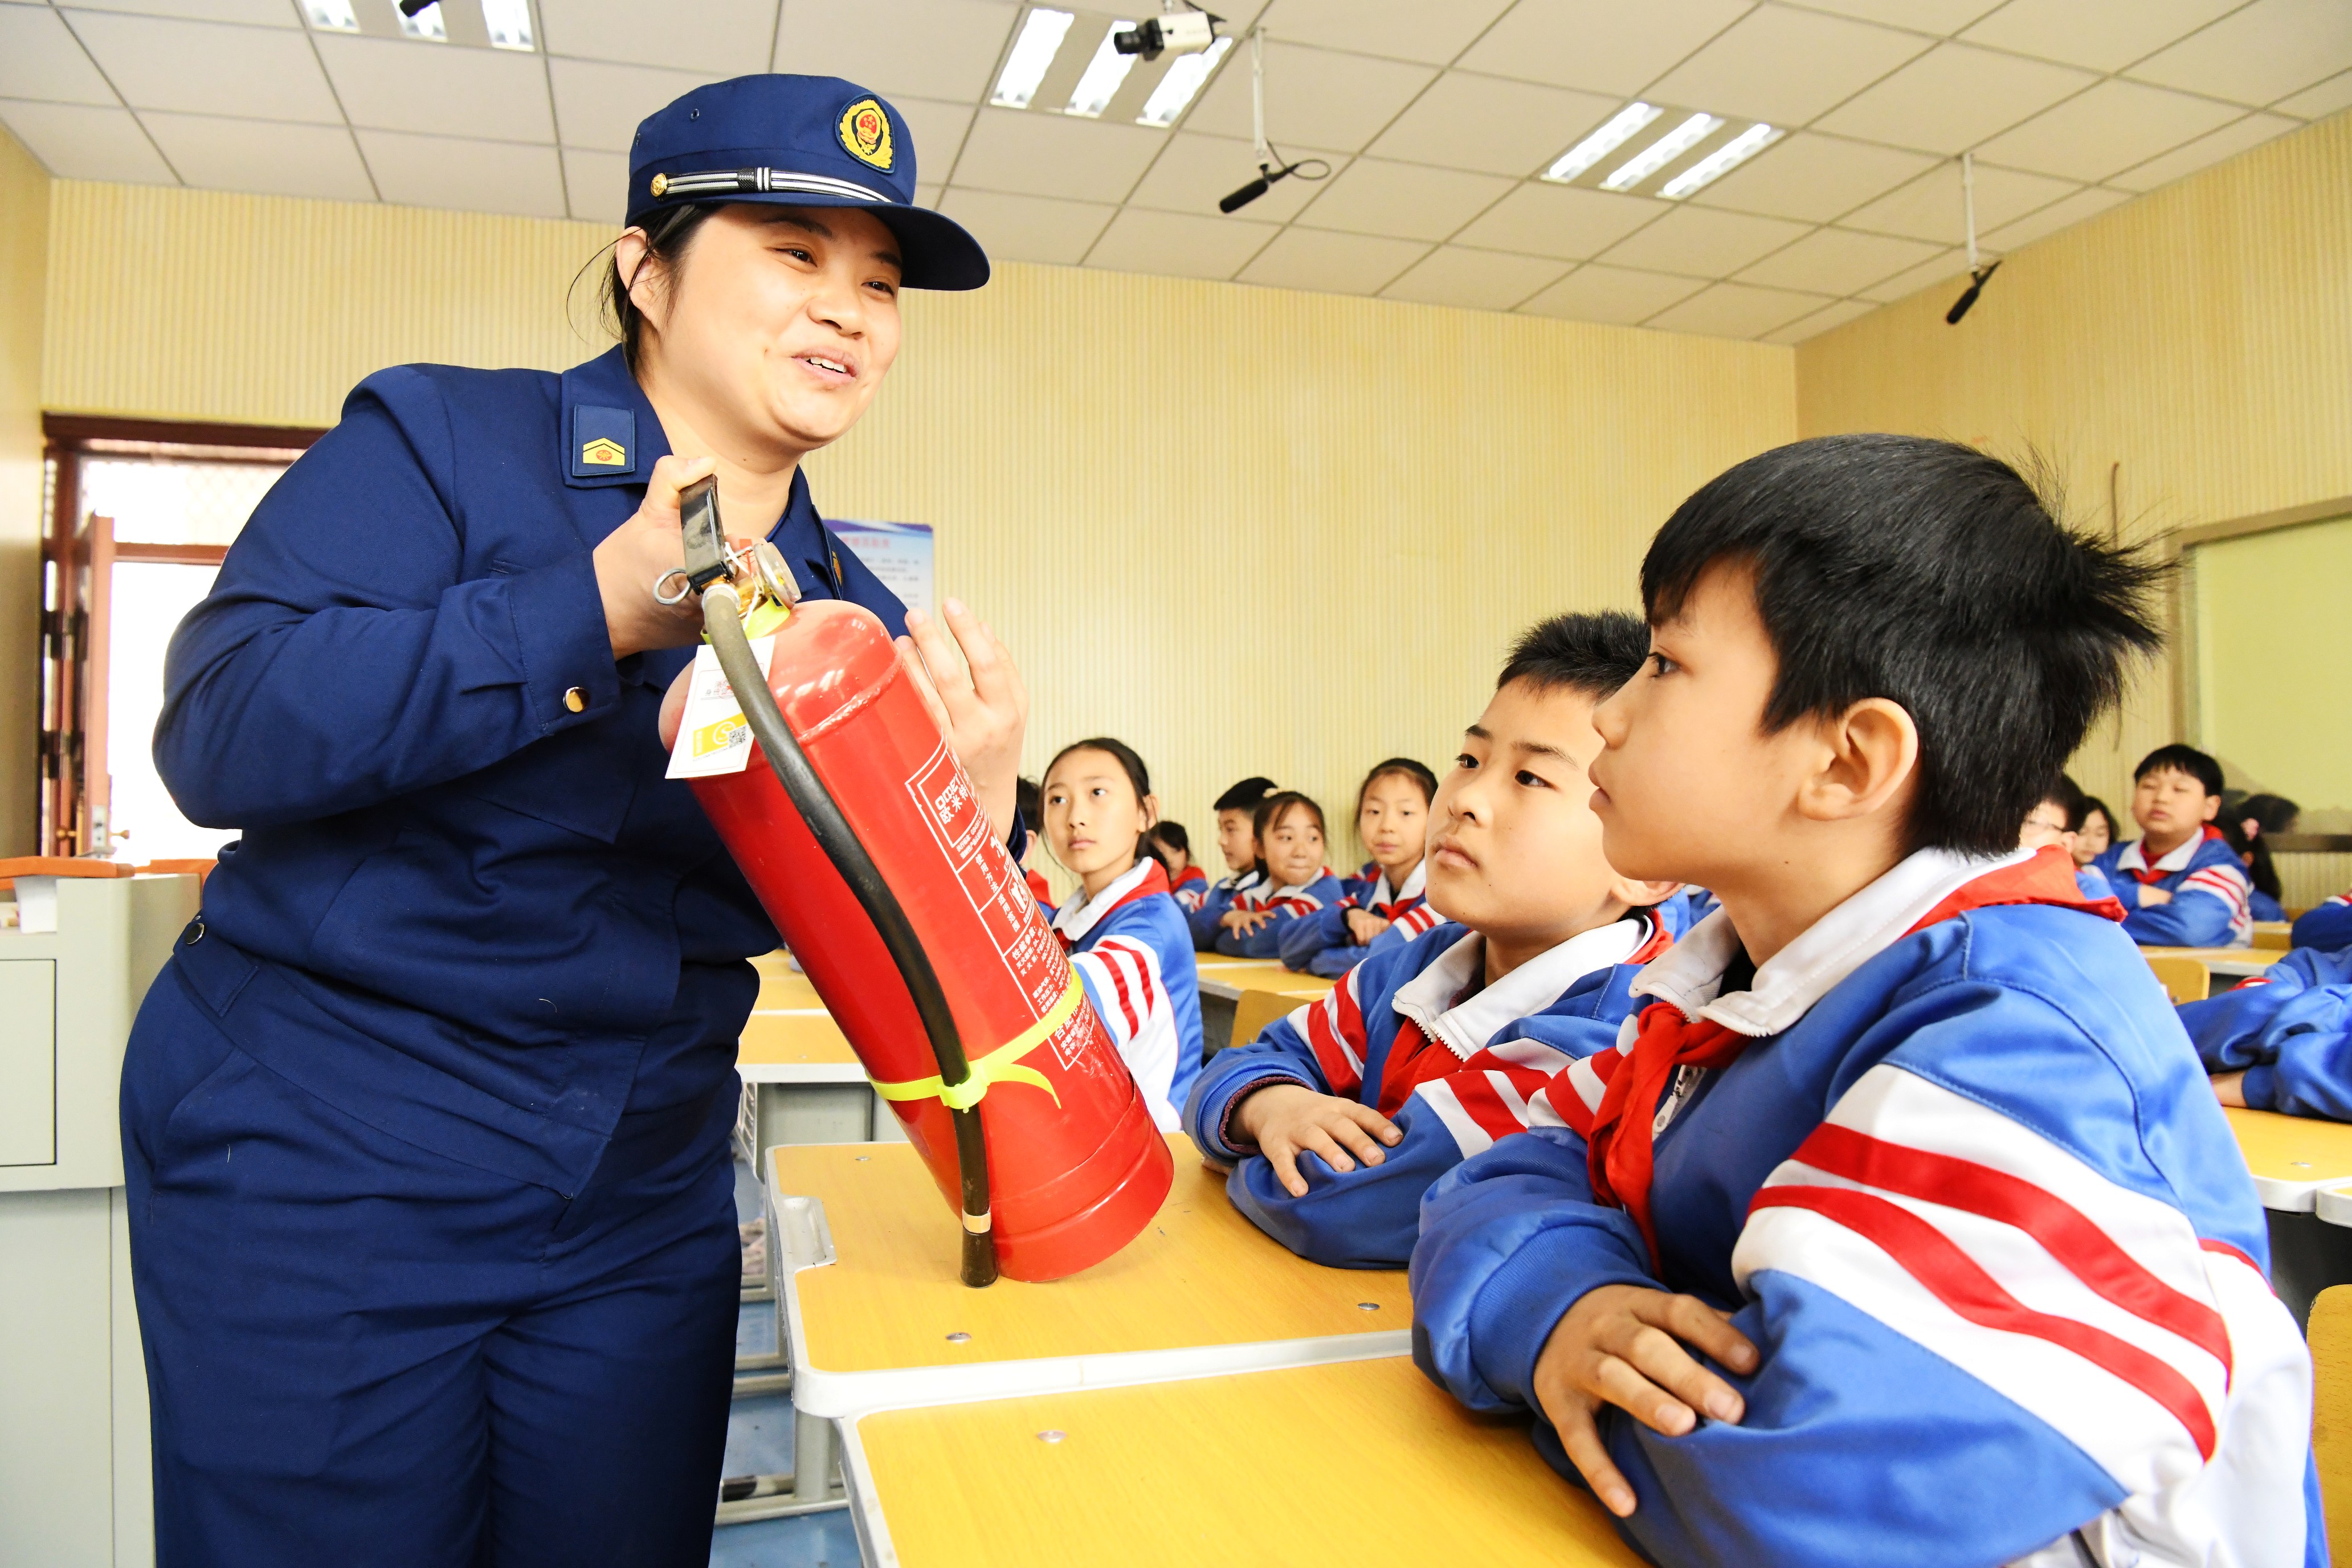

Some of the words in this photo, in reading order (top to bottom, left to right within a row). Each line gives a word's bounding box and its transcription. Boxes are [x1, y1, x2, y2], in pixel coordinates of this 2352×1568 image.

[939, 785, 967, 824] 欧米特
[975, 854, 999, 893] 使用方法
[997, 893, 1020, 932] 适用范围
[1012, 926, 1036, 960] 性能参数：
